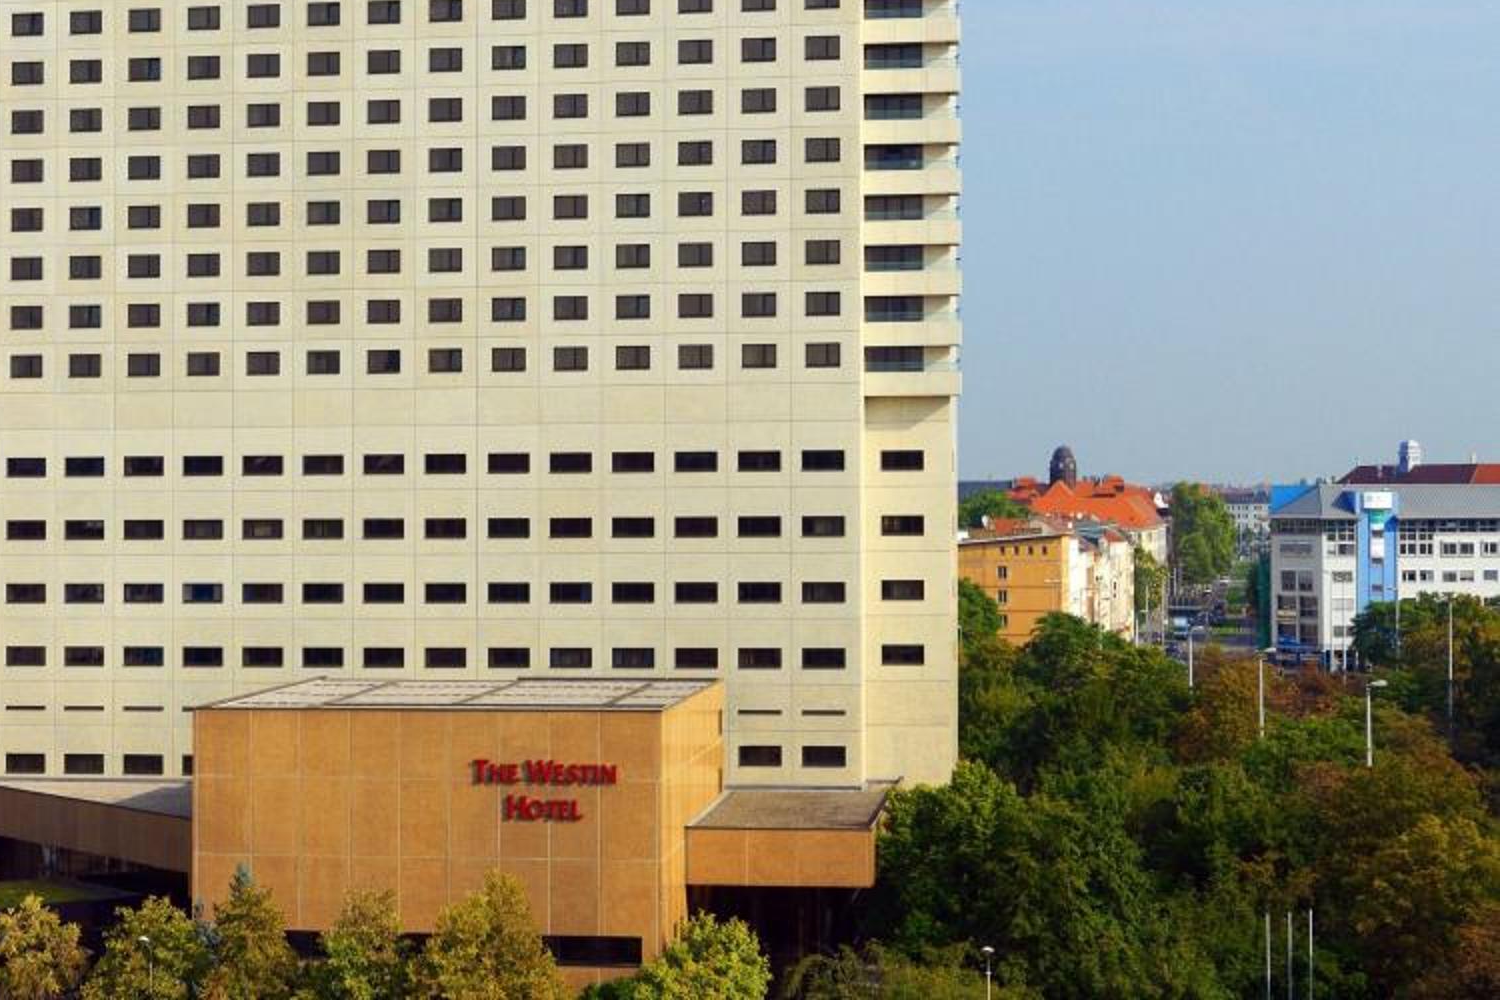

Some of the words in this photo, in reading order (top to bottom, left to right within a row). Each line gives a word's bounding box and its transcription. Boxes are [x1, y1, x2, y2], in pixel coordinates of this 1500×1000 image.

[473, 759, 520, 785] THE
[523, 759, 617, 786] WESTIN
[503, 795, 582, 821] HOTEL
